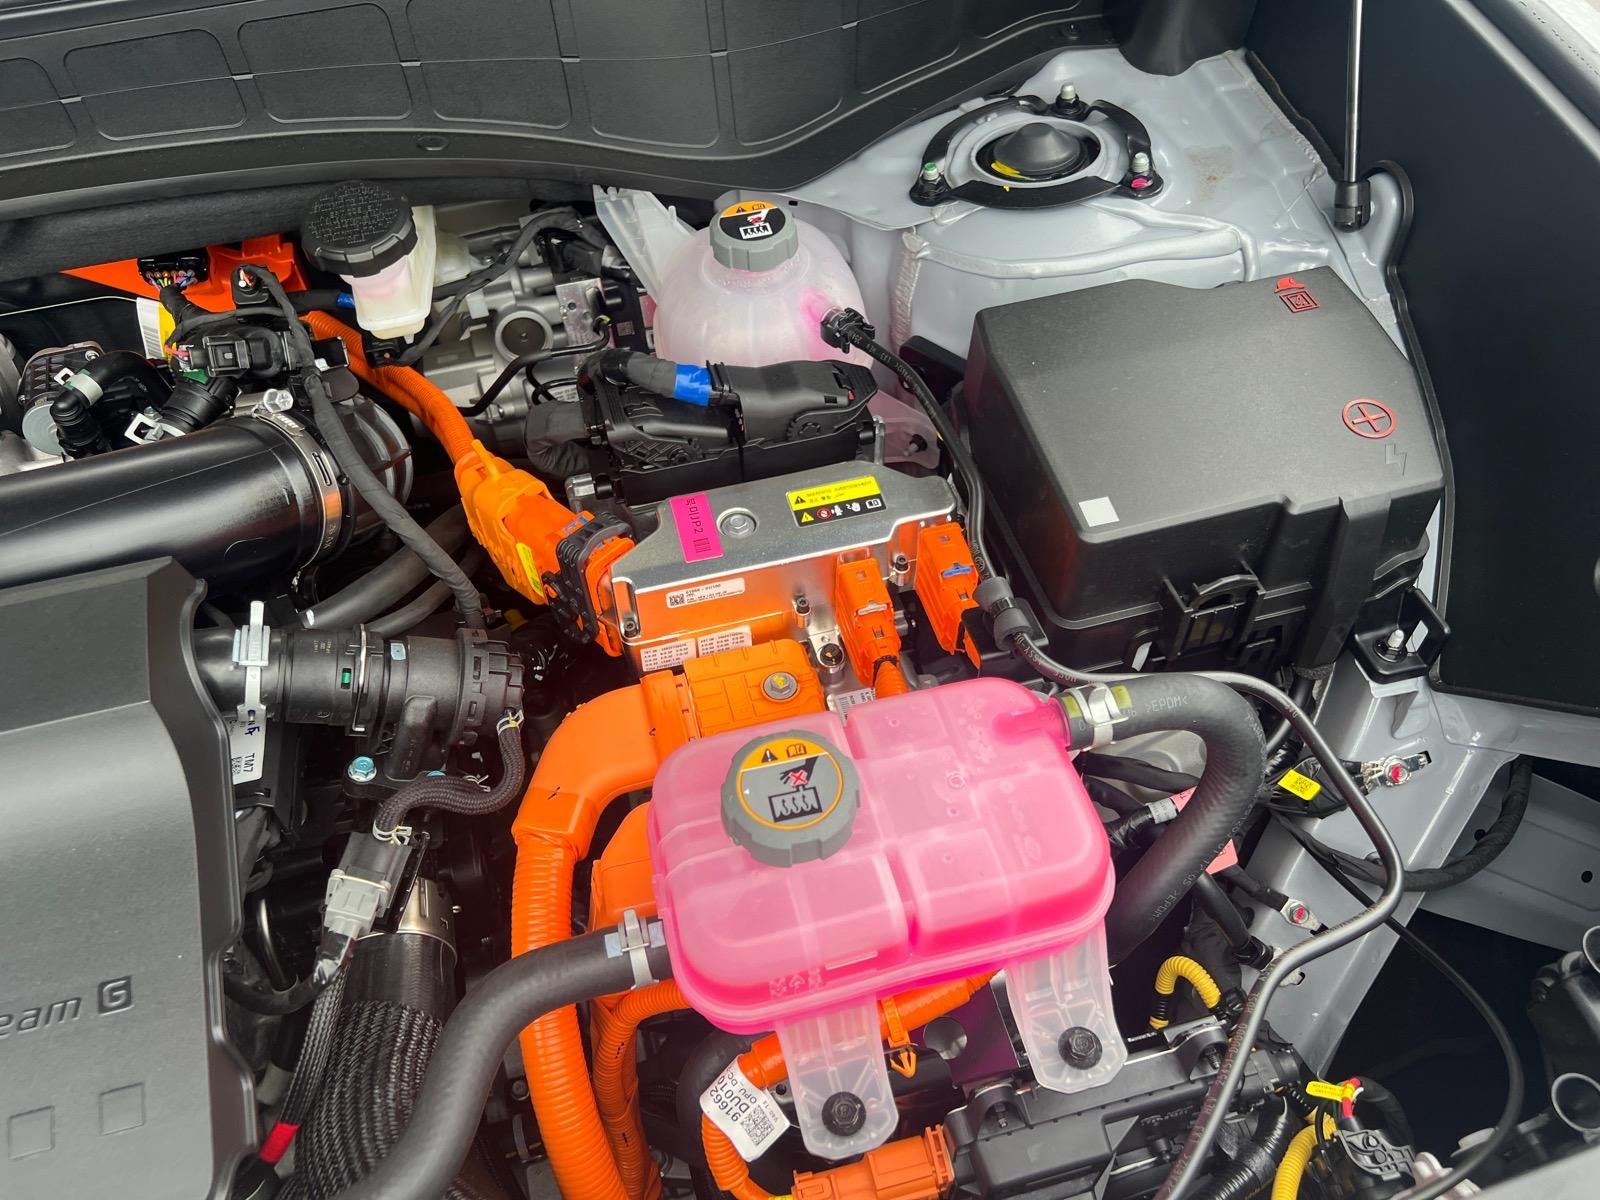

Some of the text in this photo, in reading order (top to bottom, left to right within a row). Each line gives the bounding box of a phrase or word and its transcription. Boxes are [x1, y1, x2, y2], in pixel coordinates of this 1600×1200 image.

[243, 753, 256, 773] TM7
[98, 976, 131, 1013] G
[709, 1085, 742, 1122] 91662
[717, 1075, 751, 1114] DU010
